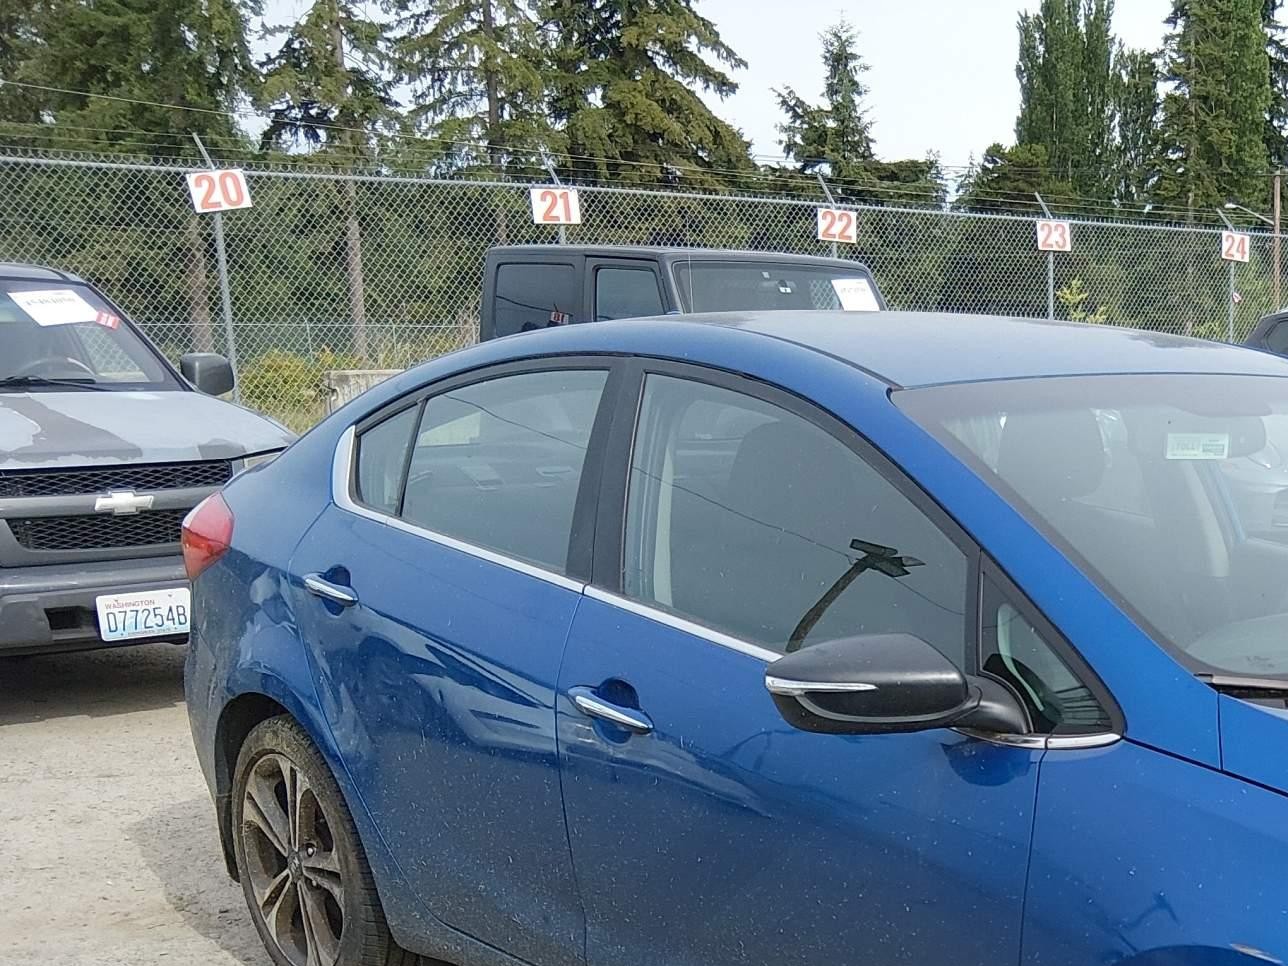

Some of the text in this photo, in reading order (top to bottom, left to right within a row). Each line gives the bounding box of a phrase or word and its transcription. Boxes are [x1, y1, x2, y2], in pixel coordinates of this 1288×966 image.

[194, 171, 244, 209] 20
[540, 190, 572, 221] 21
[821, 211, 852, 240] 22
[1040, 223, 1067, 249] 23
[1225, 235, 1246, 260] 24
[105, 600, 155, 609] WASHINGTON
[106, 605, 187, 632] D77254B
